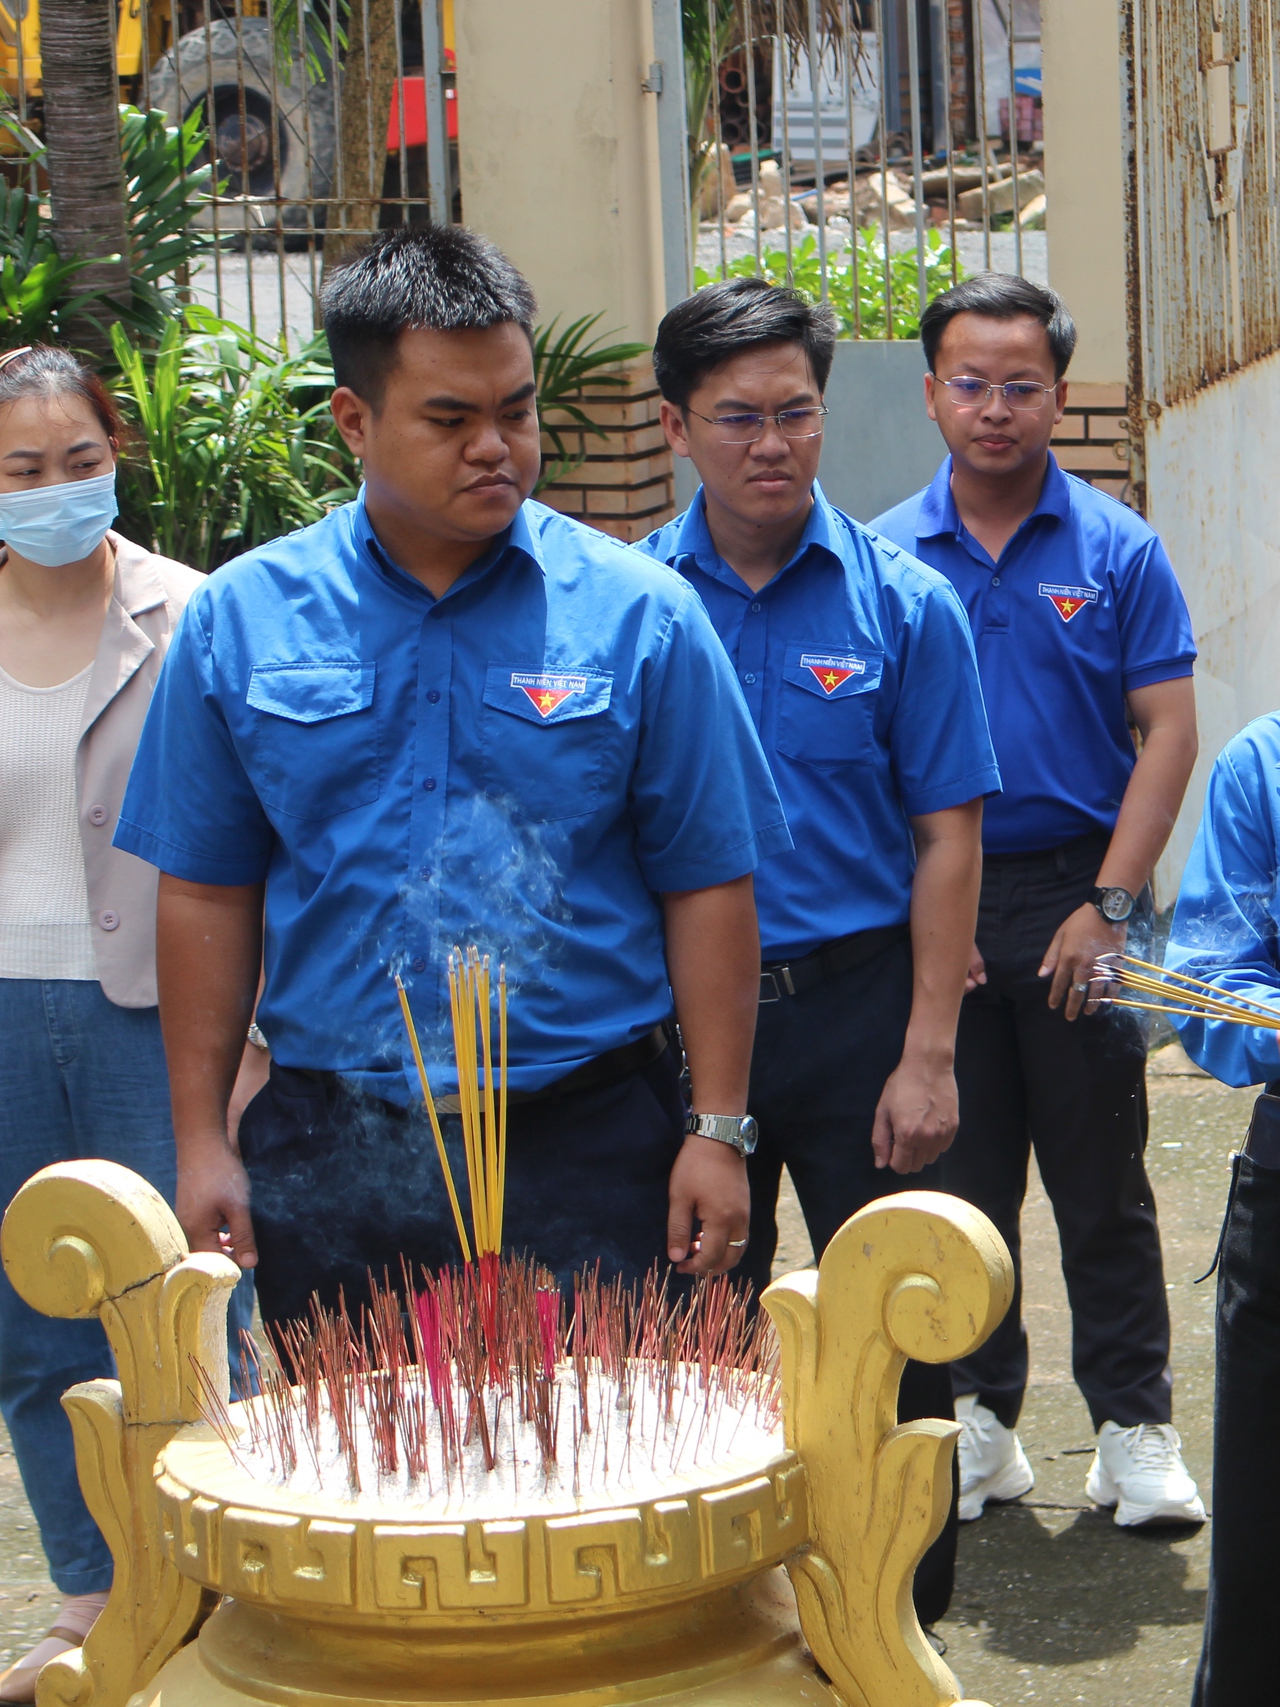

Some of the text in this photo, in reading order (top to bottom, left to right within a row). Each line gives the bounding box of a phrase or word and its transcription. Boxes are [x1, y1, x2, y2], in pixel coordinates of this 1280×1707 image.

[514, 676, 584, 689] THANH NIÊN VIỆT NAM
